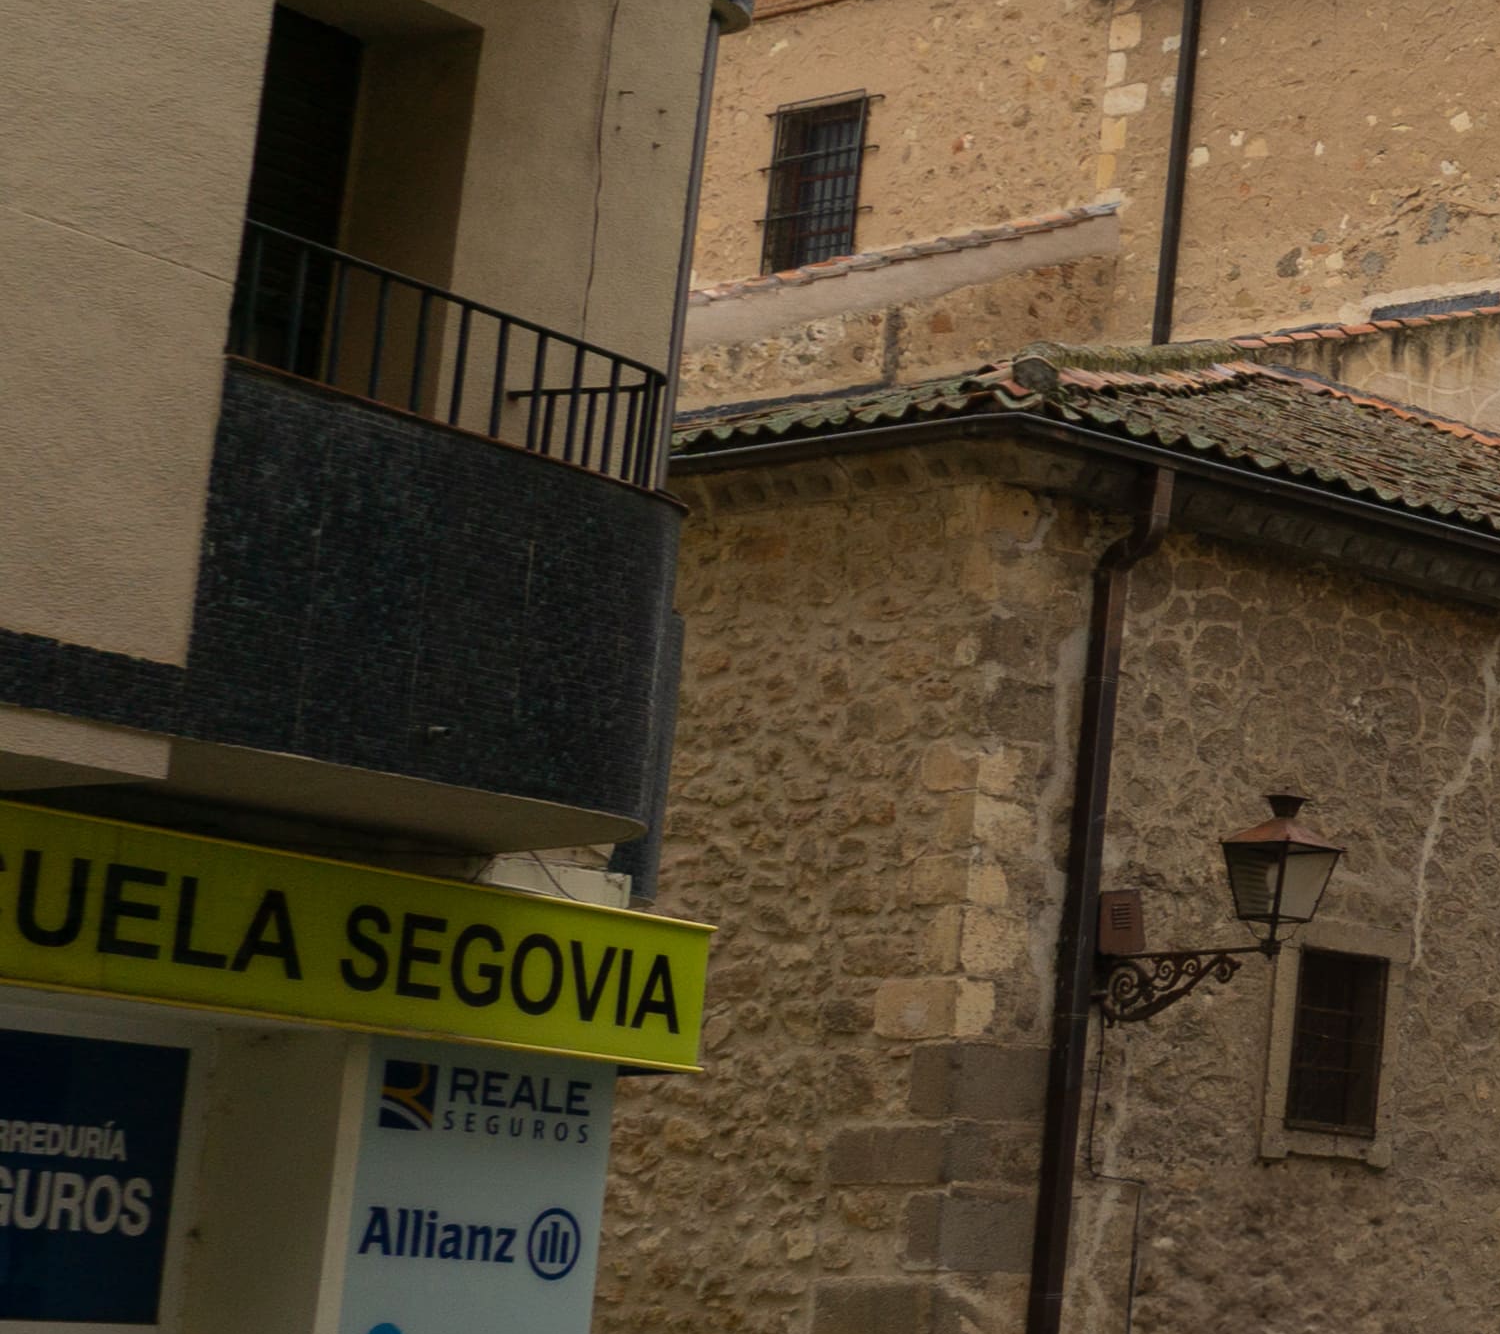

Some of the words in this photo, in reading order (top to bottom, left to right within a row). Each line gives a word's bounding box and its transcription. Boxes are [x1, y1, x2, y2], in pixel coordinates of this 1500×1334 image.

[0, 850, 304, 981] UELA
[340, 904, 681, 1035] SEGOVIA
[449, 1068, 592, 1117] REALE
[442, 1108, 590, 1145] SEGUROS
[358, 1206, 516, 1265] Allianz
